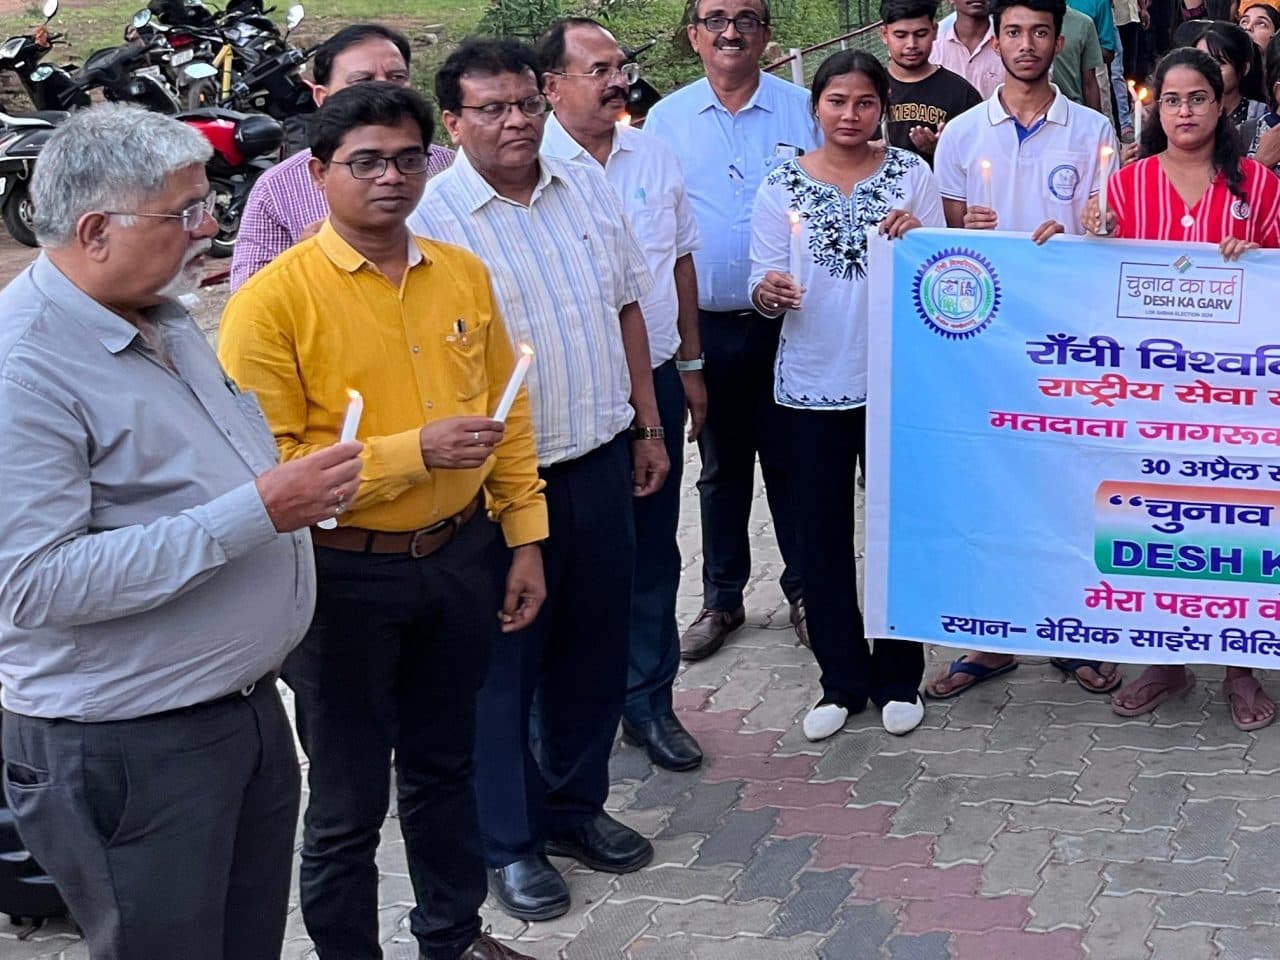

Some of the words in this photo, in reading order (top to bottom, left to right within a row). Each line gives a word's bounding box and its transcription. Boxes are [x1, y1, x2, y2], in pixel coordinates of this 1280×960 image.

[1126, 275, 1176, 298] चुनाव
[1178, 278, 1206, 295] का
[1209, 275, 1238, 296] पर्व
[1143, 295, 1175, 308] DESH
[1177, 296, 1196, 309] KA
[1197, 298, 1233, 311] GARV
[1026, 332, 1125, 368] राँची
[1037, 373, 1164, 407] राष्ट्रीय
[1174, 379, 1258, 406] सेवा
[989, 410, 1129, 439] मतदाता
[1141, 458, 1171, 476] 30
[1179, 454, 1263, 481] अप्रैल
[1112, 539, 1243, 576] DESH
[1084, 580, 1146, 612] मेरा
[1153, 591, 1250, 619] पहला
[1036, 617, 1123, 645] बेसिक
[1129, 625, 1213, 652] साइंस
